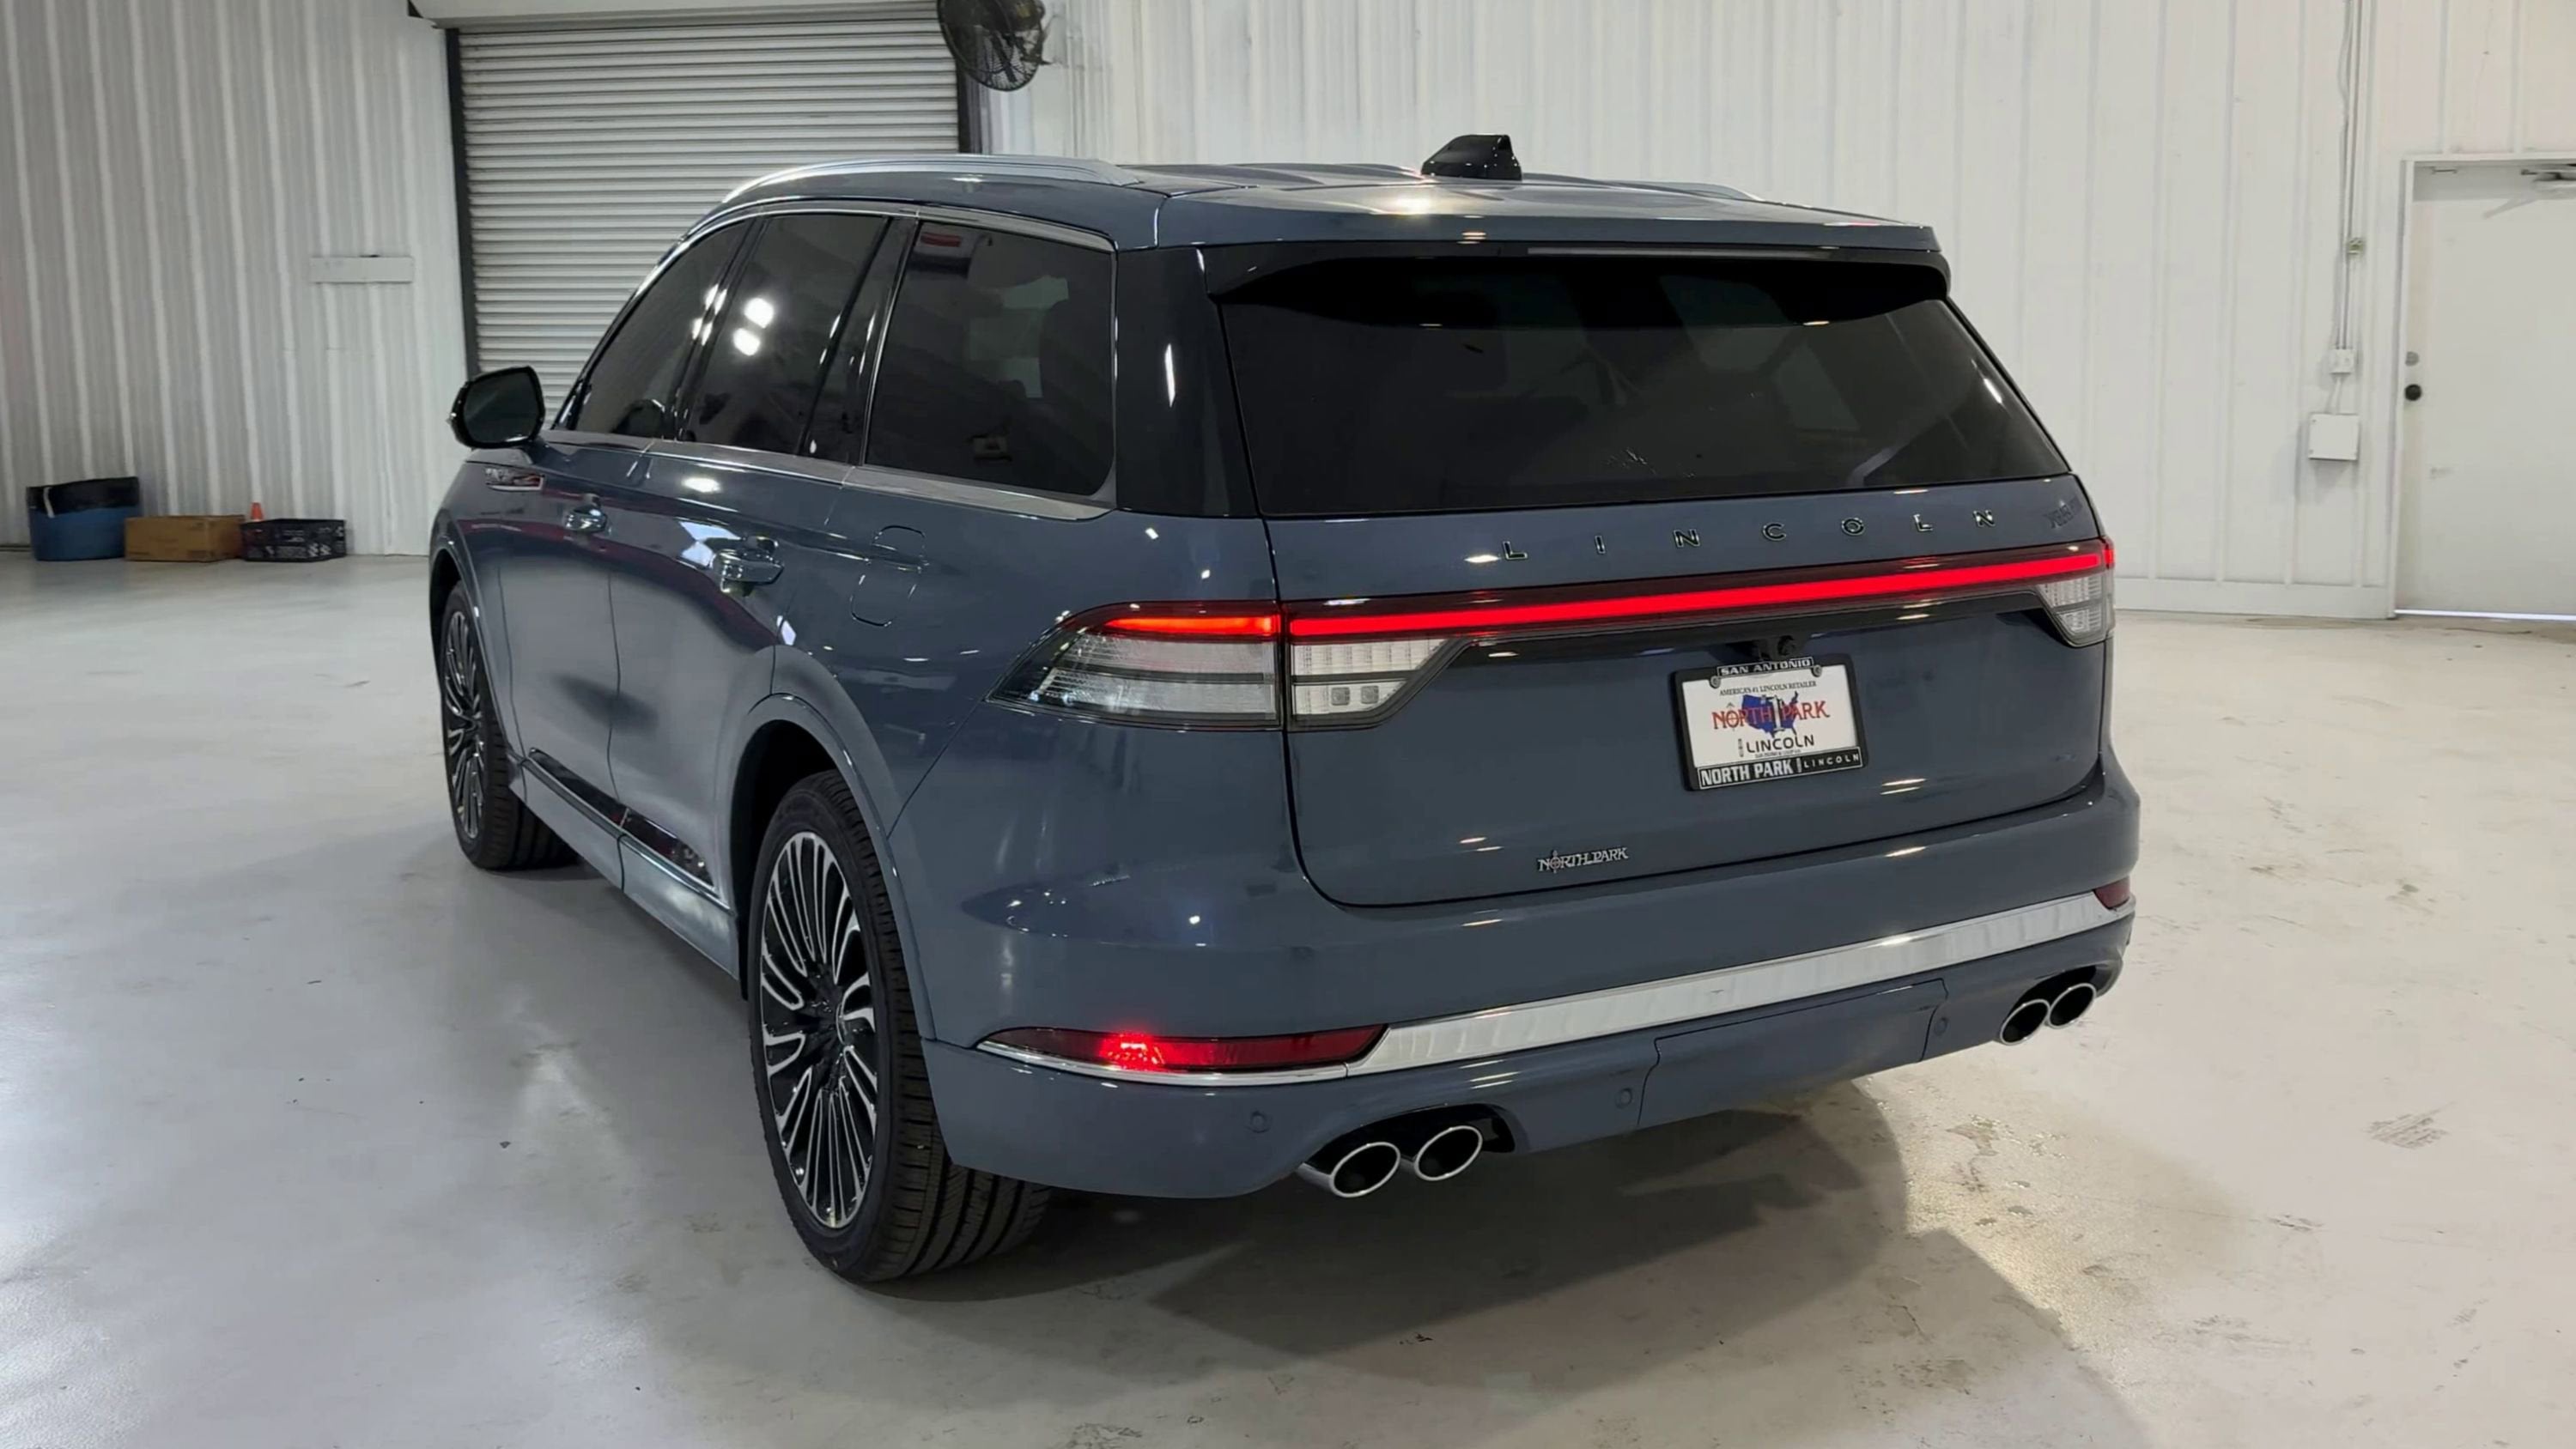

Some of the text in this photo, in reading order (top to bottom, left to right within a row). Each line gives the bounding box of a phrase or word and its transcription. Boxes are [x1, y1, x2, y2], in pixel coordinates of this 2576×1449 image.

[1503, 510, 1996, 560] LINCOLN
[1721, 658, 1811, 676] SAN ANTONIO
[1759, 682, 1789, 693] LINCOLN
[1788, 680, 1817, 689] RETAILER
[1711, 700, 1831, 730] NORTH PARK
[1747, 734, 1814, 753] LINCOLN
[1700, 764, 1751, 786] NORTH
[1753, 758, 1794, 779] PARK
[1804, 753, 1860, 769] LINCOLN
[1538, 846, 1629, 874] NORTH PARK
